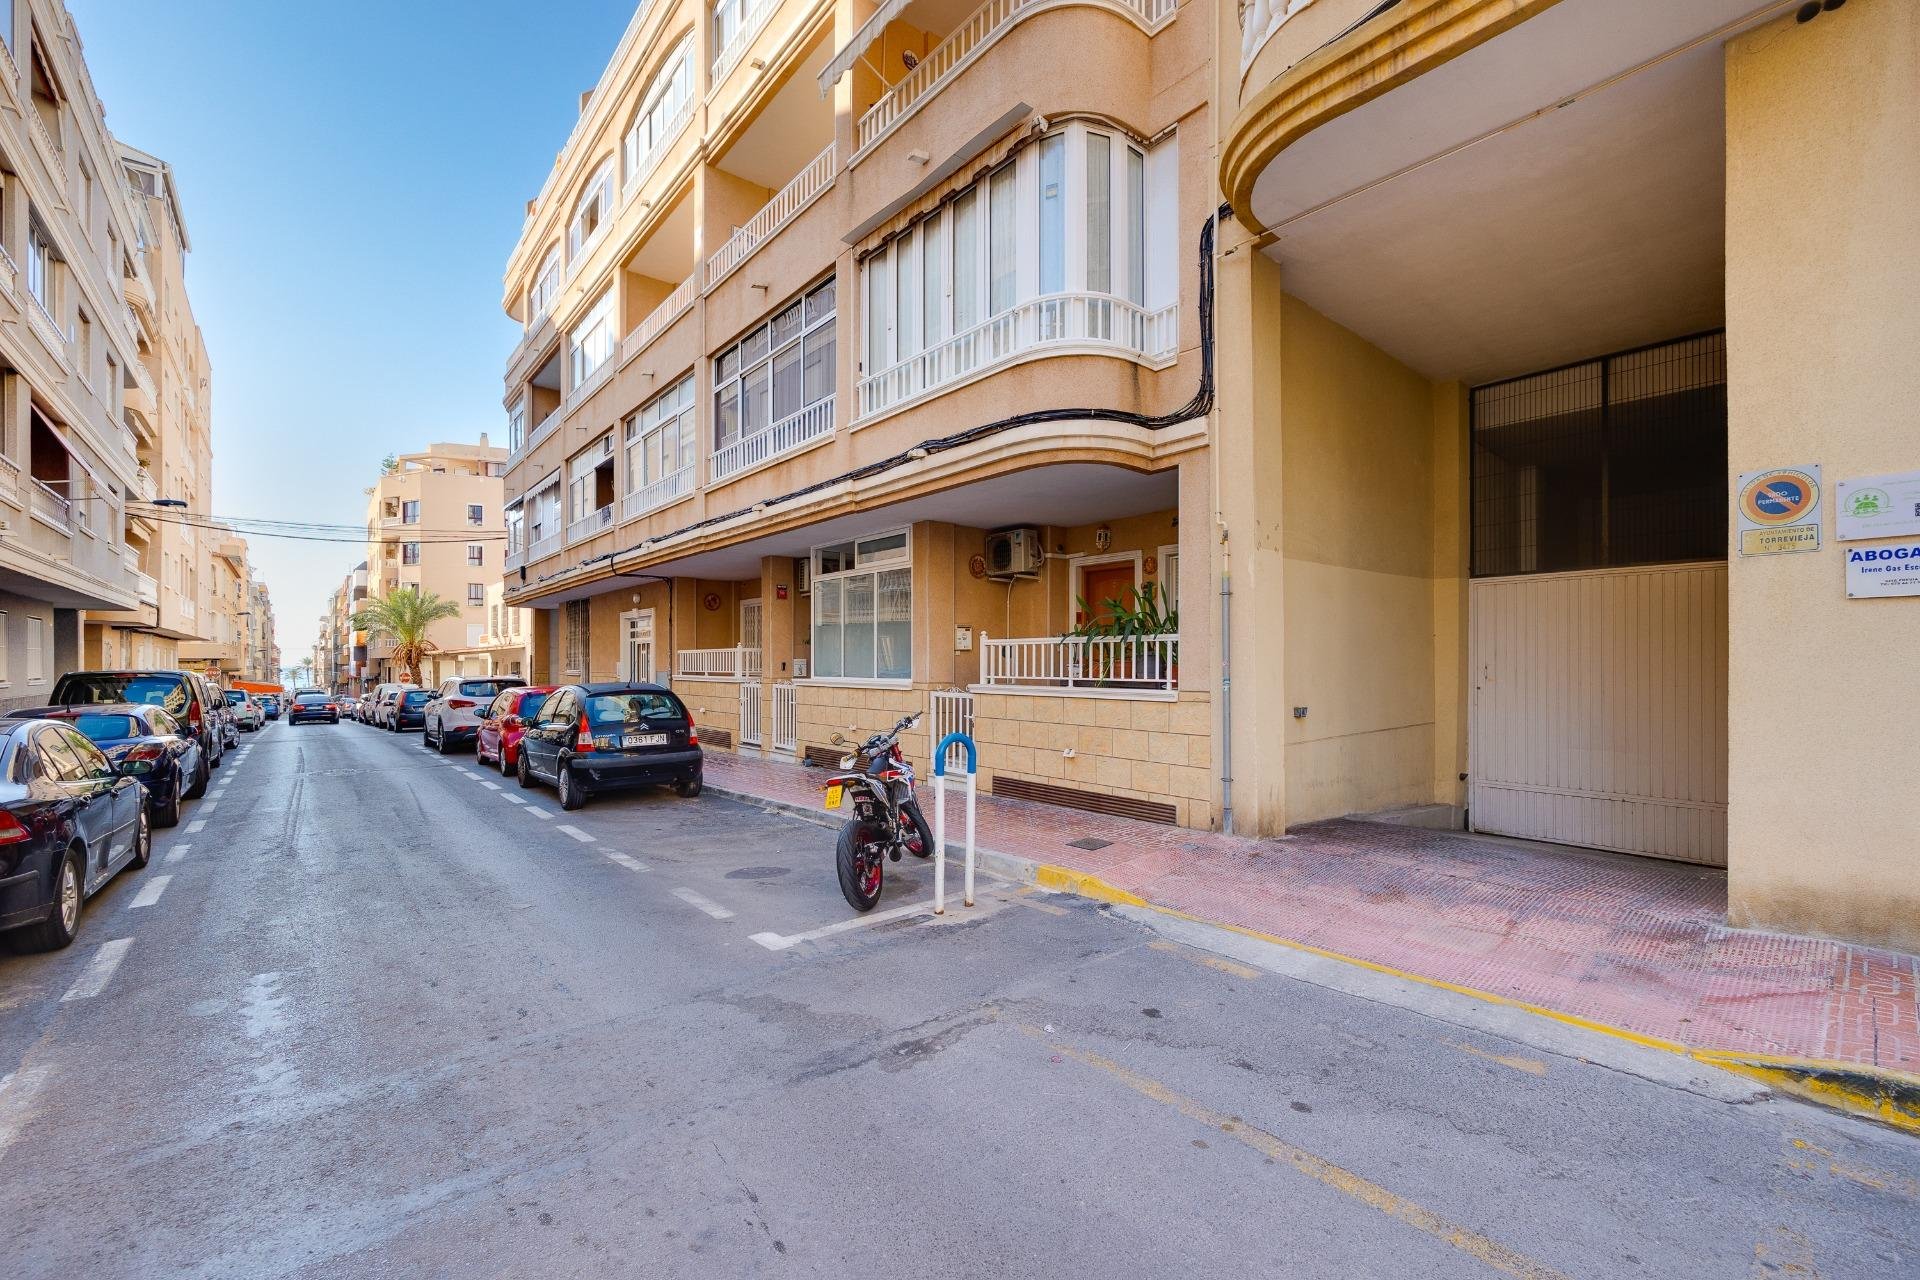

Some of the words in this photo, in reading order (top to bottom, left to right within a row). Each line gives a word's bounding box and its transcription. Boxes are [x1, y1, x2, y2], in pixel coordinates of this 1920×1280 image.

[1759, 527, 1805, 536] AYUNTAMIENTO
[1759, 533, 1815, 545] TORREVIEJA
[1861, 566, 1883, 574] Irene
[650, 734, 666, 743] FJN
